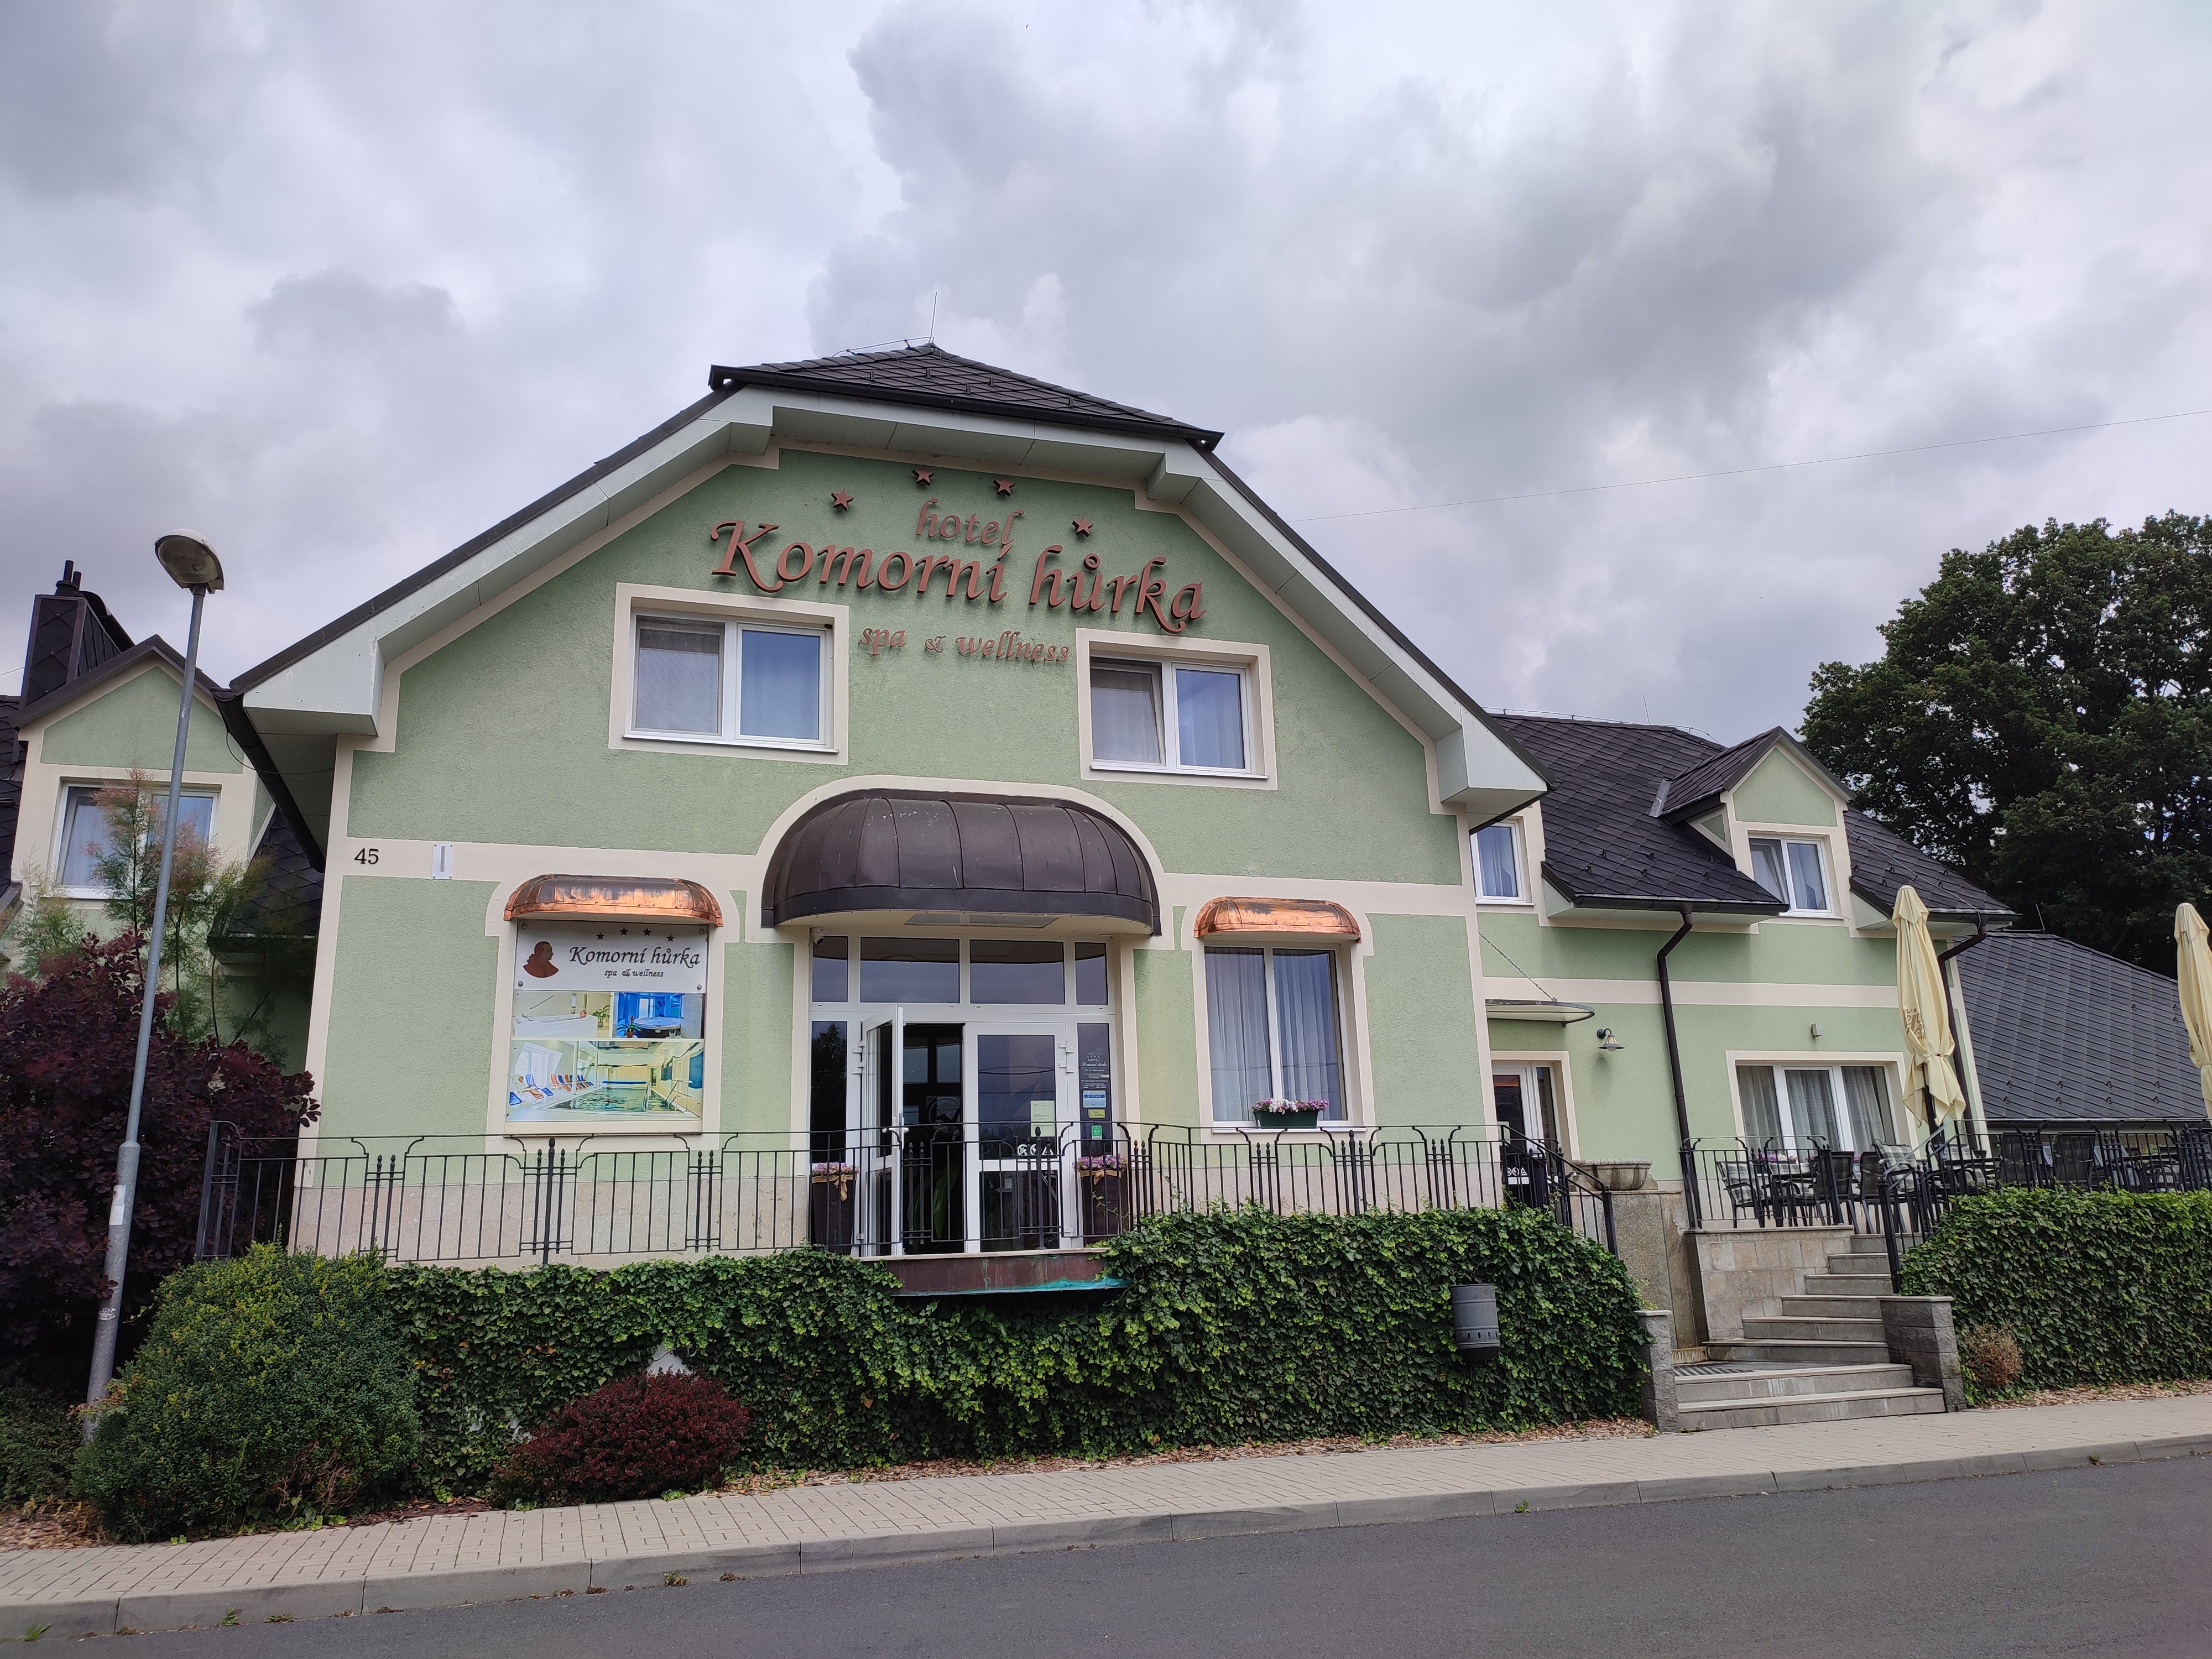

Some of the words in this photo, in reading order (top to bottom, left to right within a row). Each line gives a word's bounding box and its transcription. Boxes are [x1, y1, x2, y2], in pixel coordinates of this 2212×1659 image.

[915, 498, 1024, 546] hotel
[711, 519, 1013, 603] Komorní
[1029, 545, 1207, 634] hůrka
[858, 628, 907, 656] spa
[924, 634, 946, 653] &
[955, 630, 1070, 662] wellness
[354, 848, 379, 864] 45
[569, 946, 648, 966] Komorní
[650, 946, 700, 969] hůrka
[604, 969, 618, 978] spa
[622, 968, 631, 977] &
[632, 968, 664, 978] wellness
